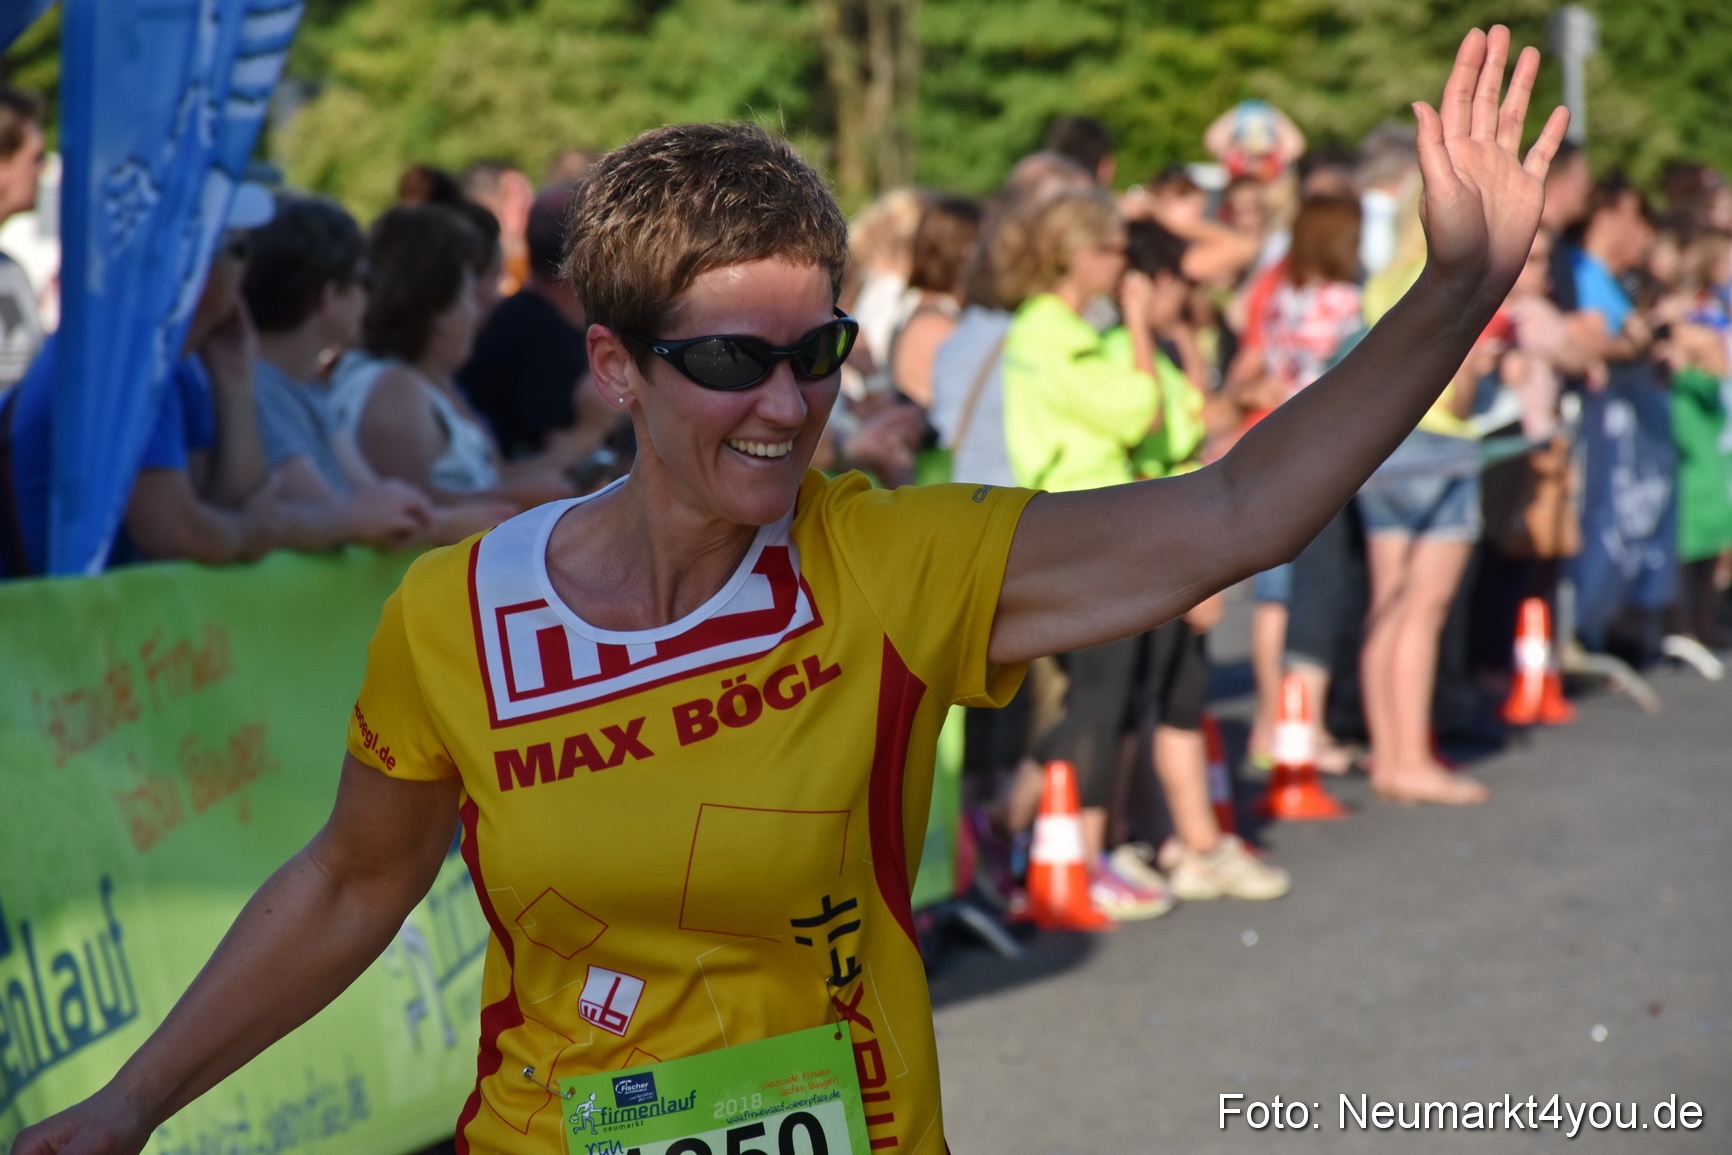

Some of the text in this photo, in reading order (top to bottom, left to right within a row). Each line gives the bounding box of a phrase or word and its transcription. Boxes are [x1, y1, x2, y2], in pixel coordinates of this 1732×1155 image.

[494, 654, 842, 792] MAX BÖGL
[621, 1080, 649, 1092] Fischer
[601, 1090, 697, 1125] firmenlauf
[713, 1093, 762, 1119] 2018
[602, 1120, 644, 1133] neumarkt
